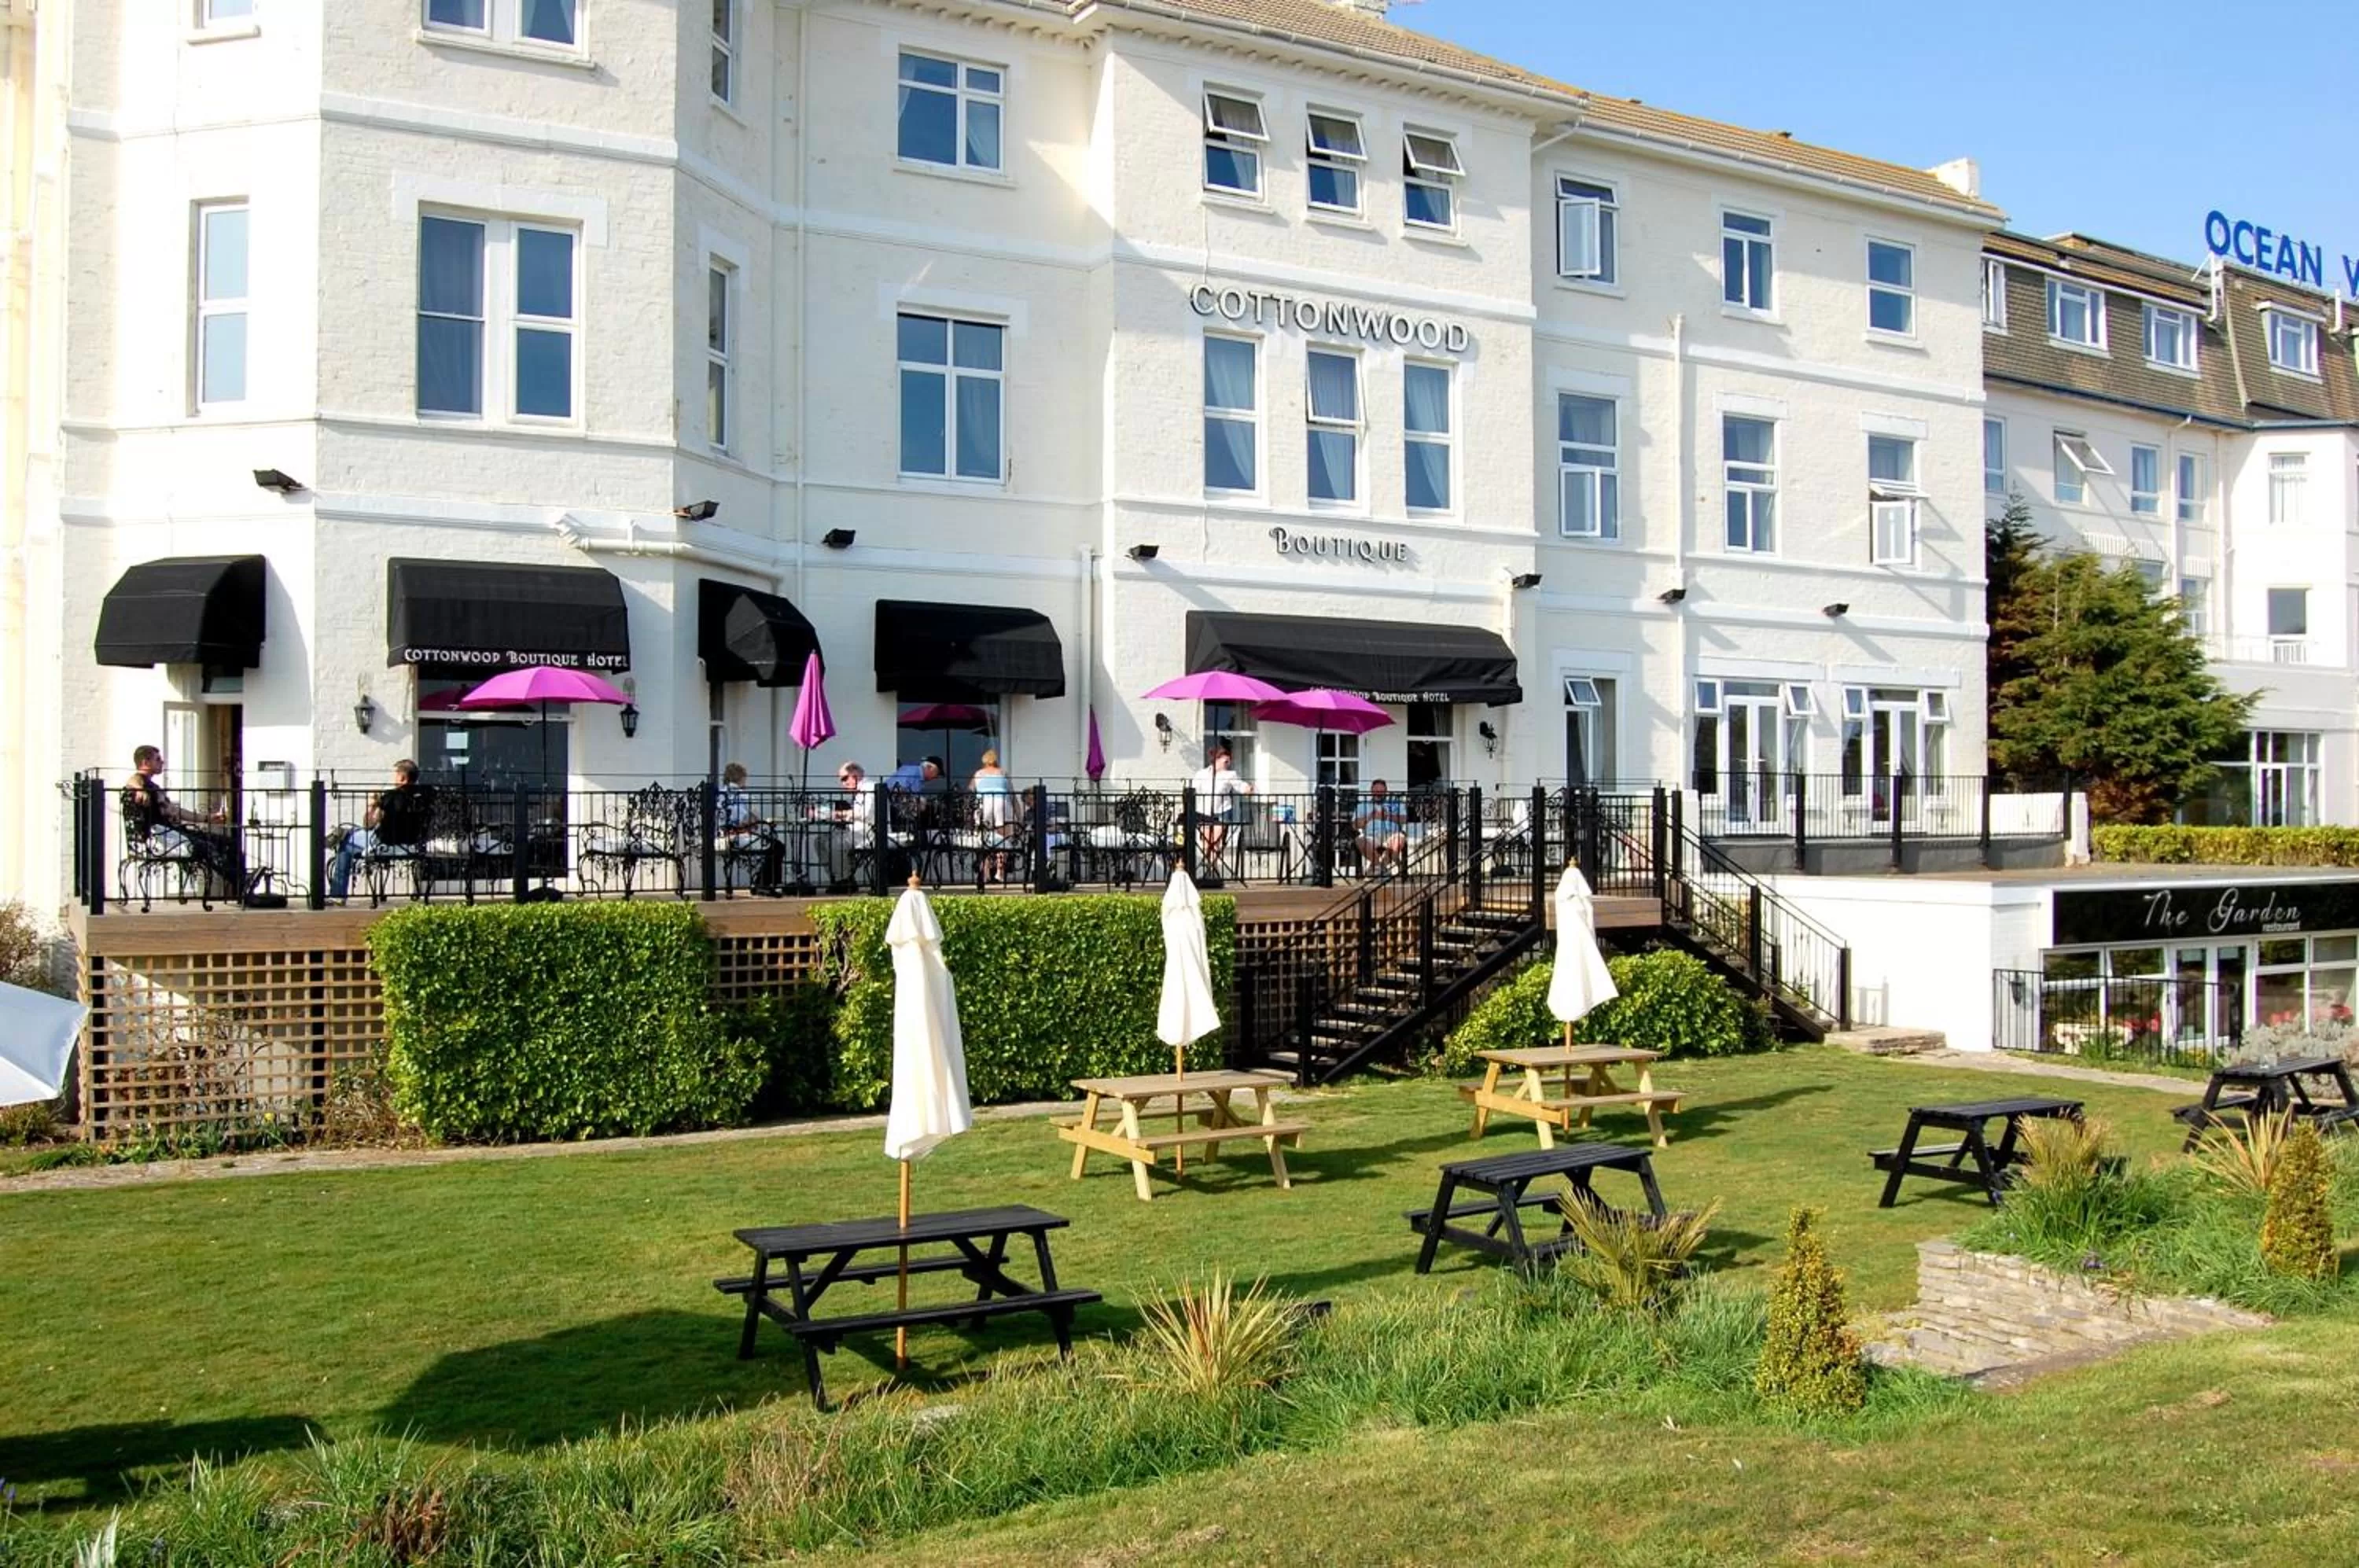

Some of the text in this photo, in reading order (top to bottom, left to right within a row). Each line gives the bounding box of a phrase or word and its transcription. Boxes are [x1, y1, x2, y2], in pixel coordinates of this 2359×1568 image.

[2205, 210, 2322, 288] OCEAN
[1190, 283, 1470, 353] COTTONWOOD
[1269, 526, 1408, 563] BOUTIQUE
[404, 648, 628, 668] COTTONWOOD BOUTIQUE HOTEL
[1371, 690, 1419, 704] BOUTIQUE
[1422, 692, 1451, 703] HOTEL
[2143, 887, 2301, 933] The Garden
